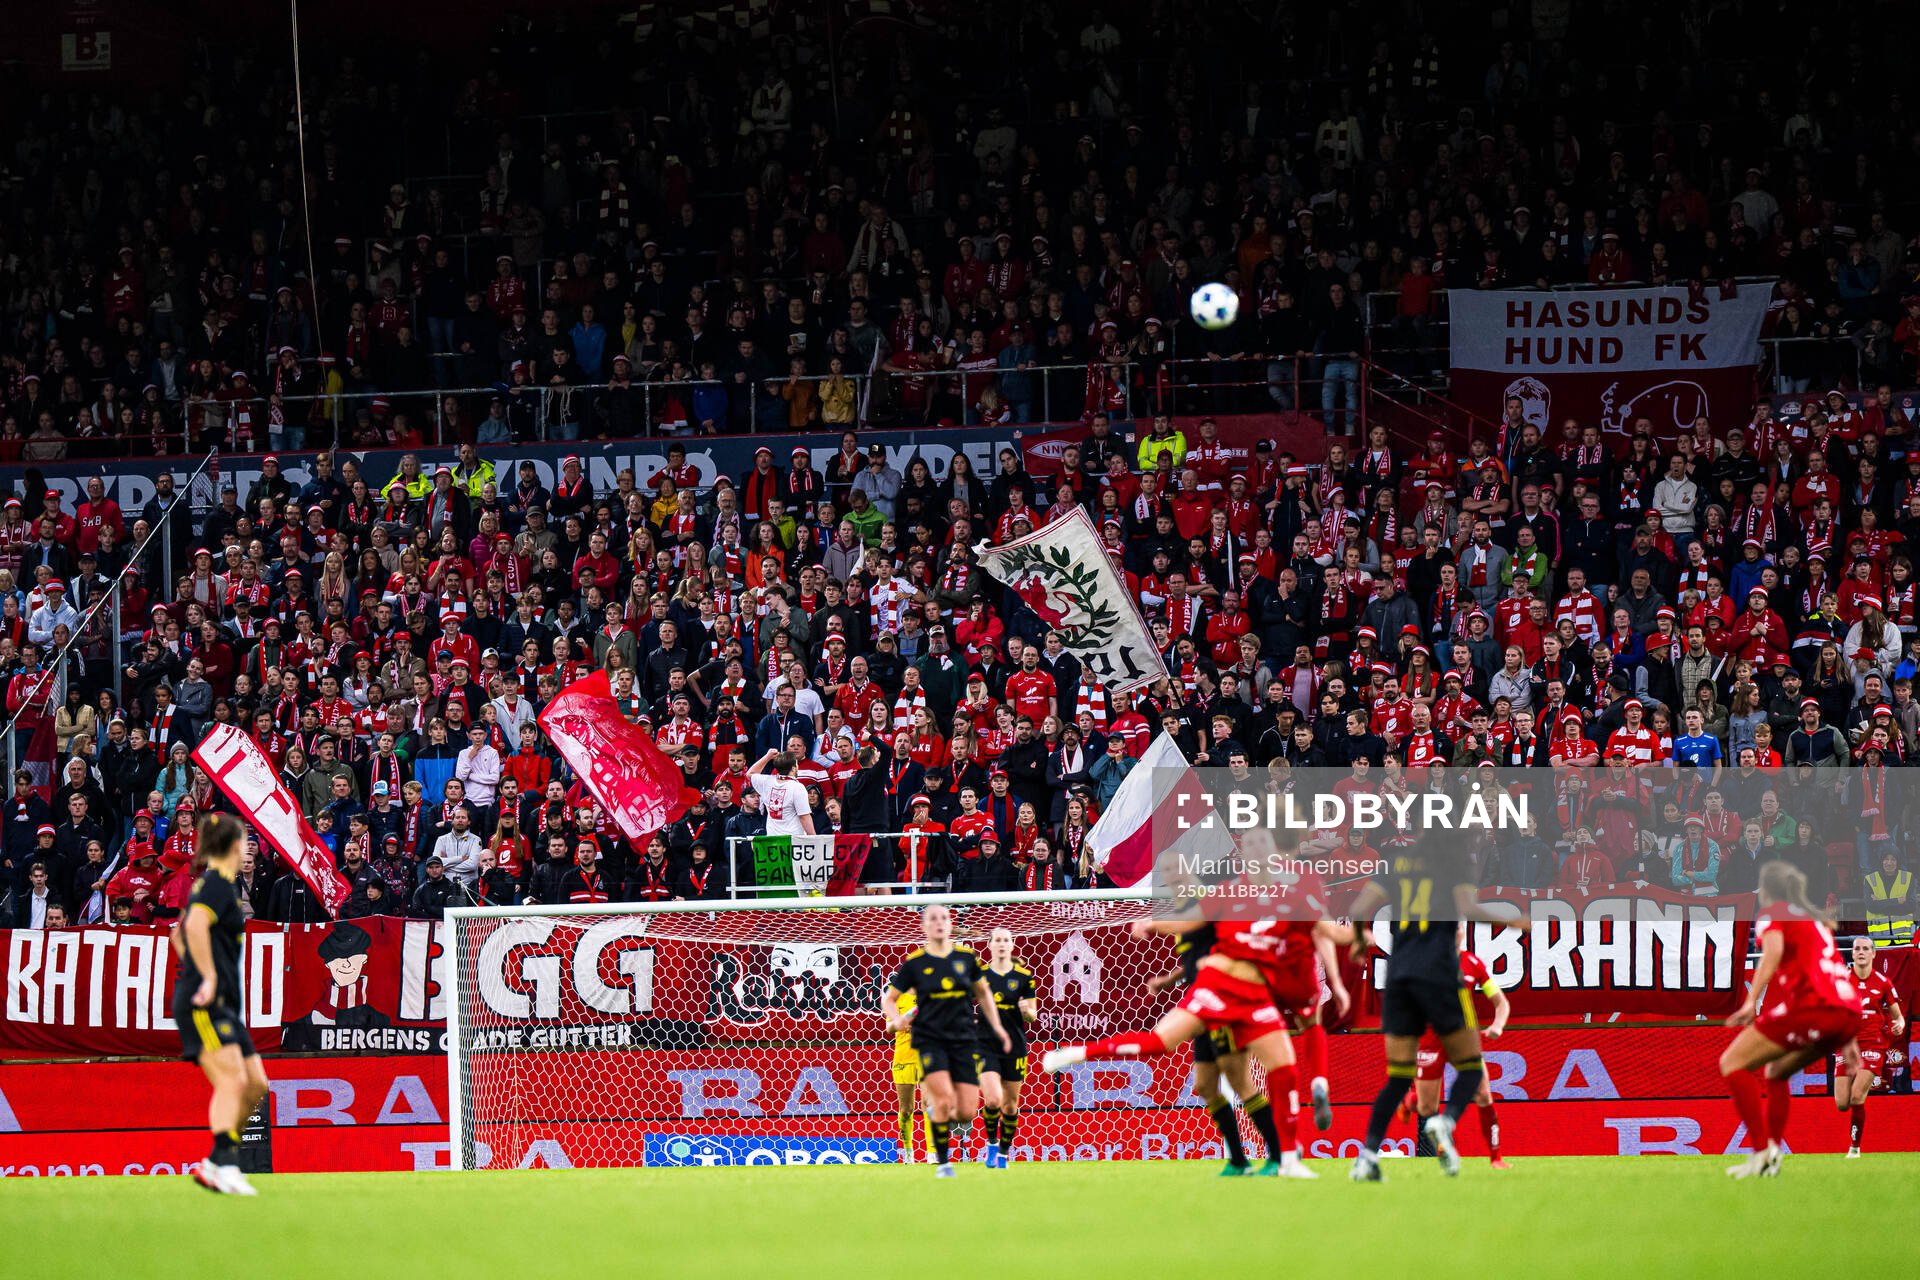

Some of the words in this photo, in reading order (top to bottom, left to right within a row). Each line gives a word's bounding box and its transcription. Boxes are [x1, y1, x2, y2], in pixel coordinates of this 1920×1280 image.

[1505, 297, 1712, 328] HASUNDS
[1505, 336, 1623, 365] HUND
[1655, 333, 1707, 362] FK
[755, 844, 814, 864] LENGE
[757, 864, 794, 885] SAN
[1399, 878, 1433, 932] 14
[320, 1027, 431, 1052] BERGENS
[530, 1024, 632, 1048] GUTTER
